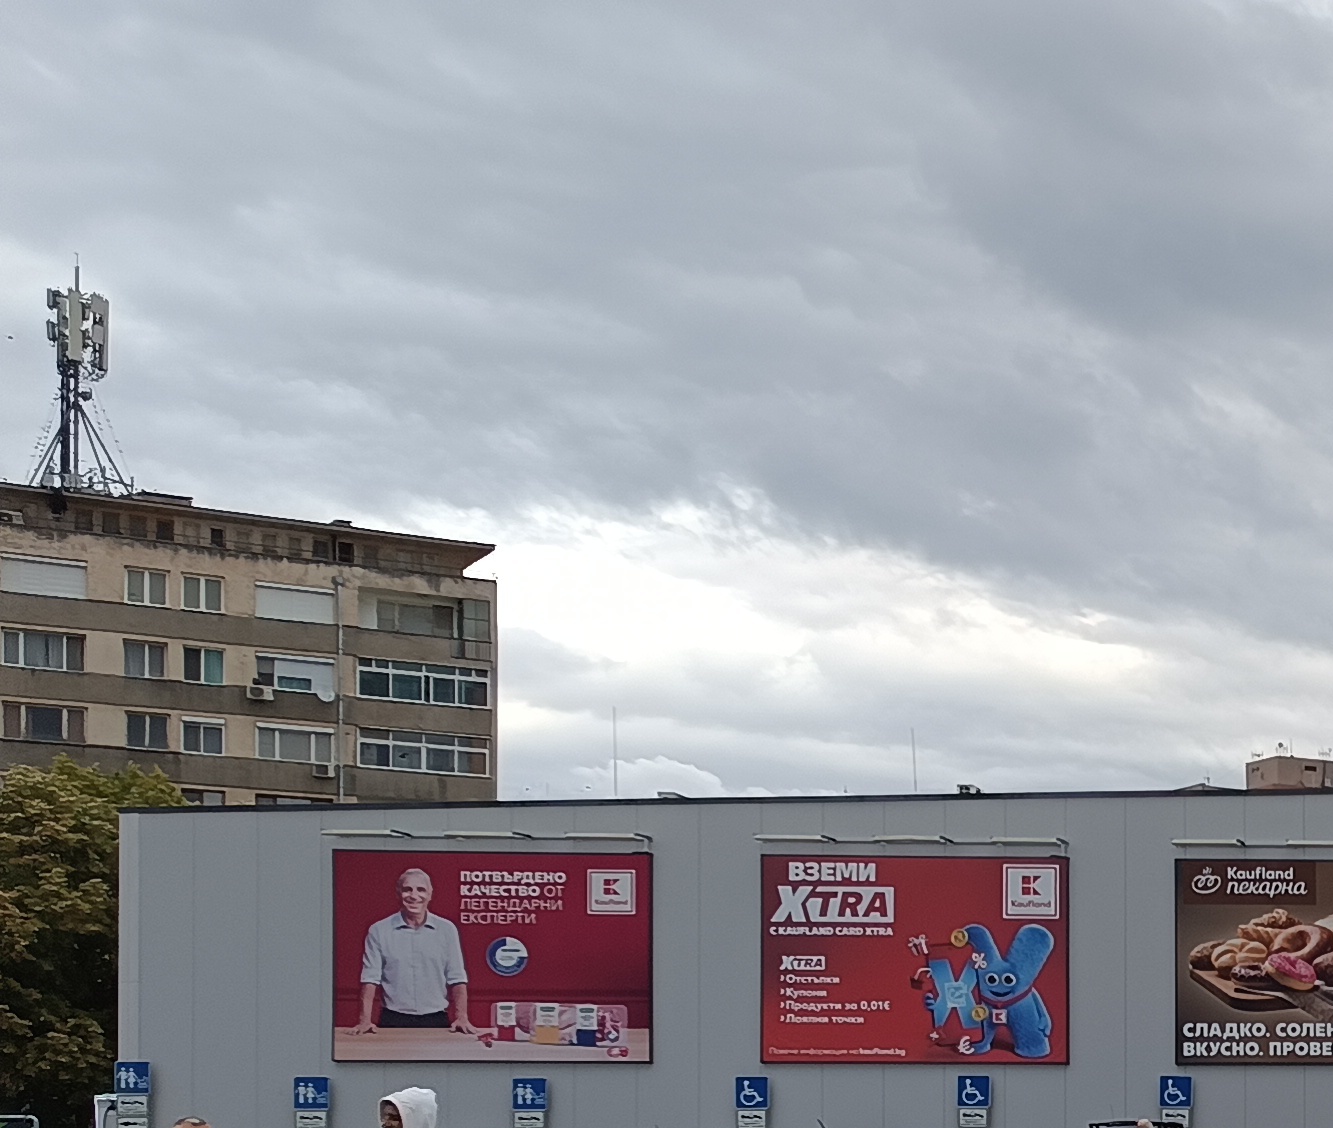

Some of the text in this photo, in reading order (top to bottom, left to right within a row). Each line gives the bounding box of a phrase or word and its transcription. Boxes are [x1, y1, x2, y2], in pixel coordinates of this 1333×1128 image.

[460, 870, 567, 885] ПОТВЪРДЕНО
[788, 861, 877, 882] ВЗЕМИ
[1226, 866, 1294, 880] Kaufland
[459, 885, 565, 898] КАЧЕСТВО ОТ
[1225, 878, 1309, 899] пекарна
[459, 898, 564, 912] ЛЕГЕНДАРНИ
[770, 885, 892, 923] XTRA
[1010, 899, 1052, 908] Kaufland
[460, 912, 537, 925] ЕКСПЕРТИ
[778, 926, 835, 936] KAUFLAND
[835, 926, 864, 936] CARD
[864, 926, 894, 936] XTRA
[780, 955, 825, 970] XTRA
[785, 974, 841, 984] Отстъпки
[785, 987, 828, 999] Купони
[785, 1000, 891, 1012] Продукти за 0,01€
[832, 1016, 865, 1024] точки
[1182, 1022, 1271, 1040] СЛАДКО.
[1182, 1041, 1264, 1057] ВКУСНО.
